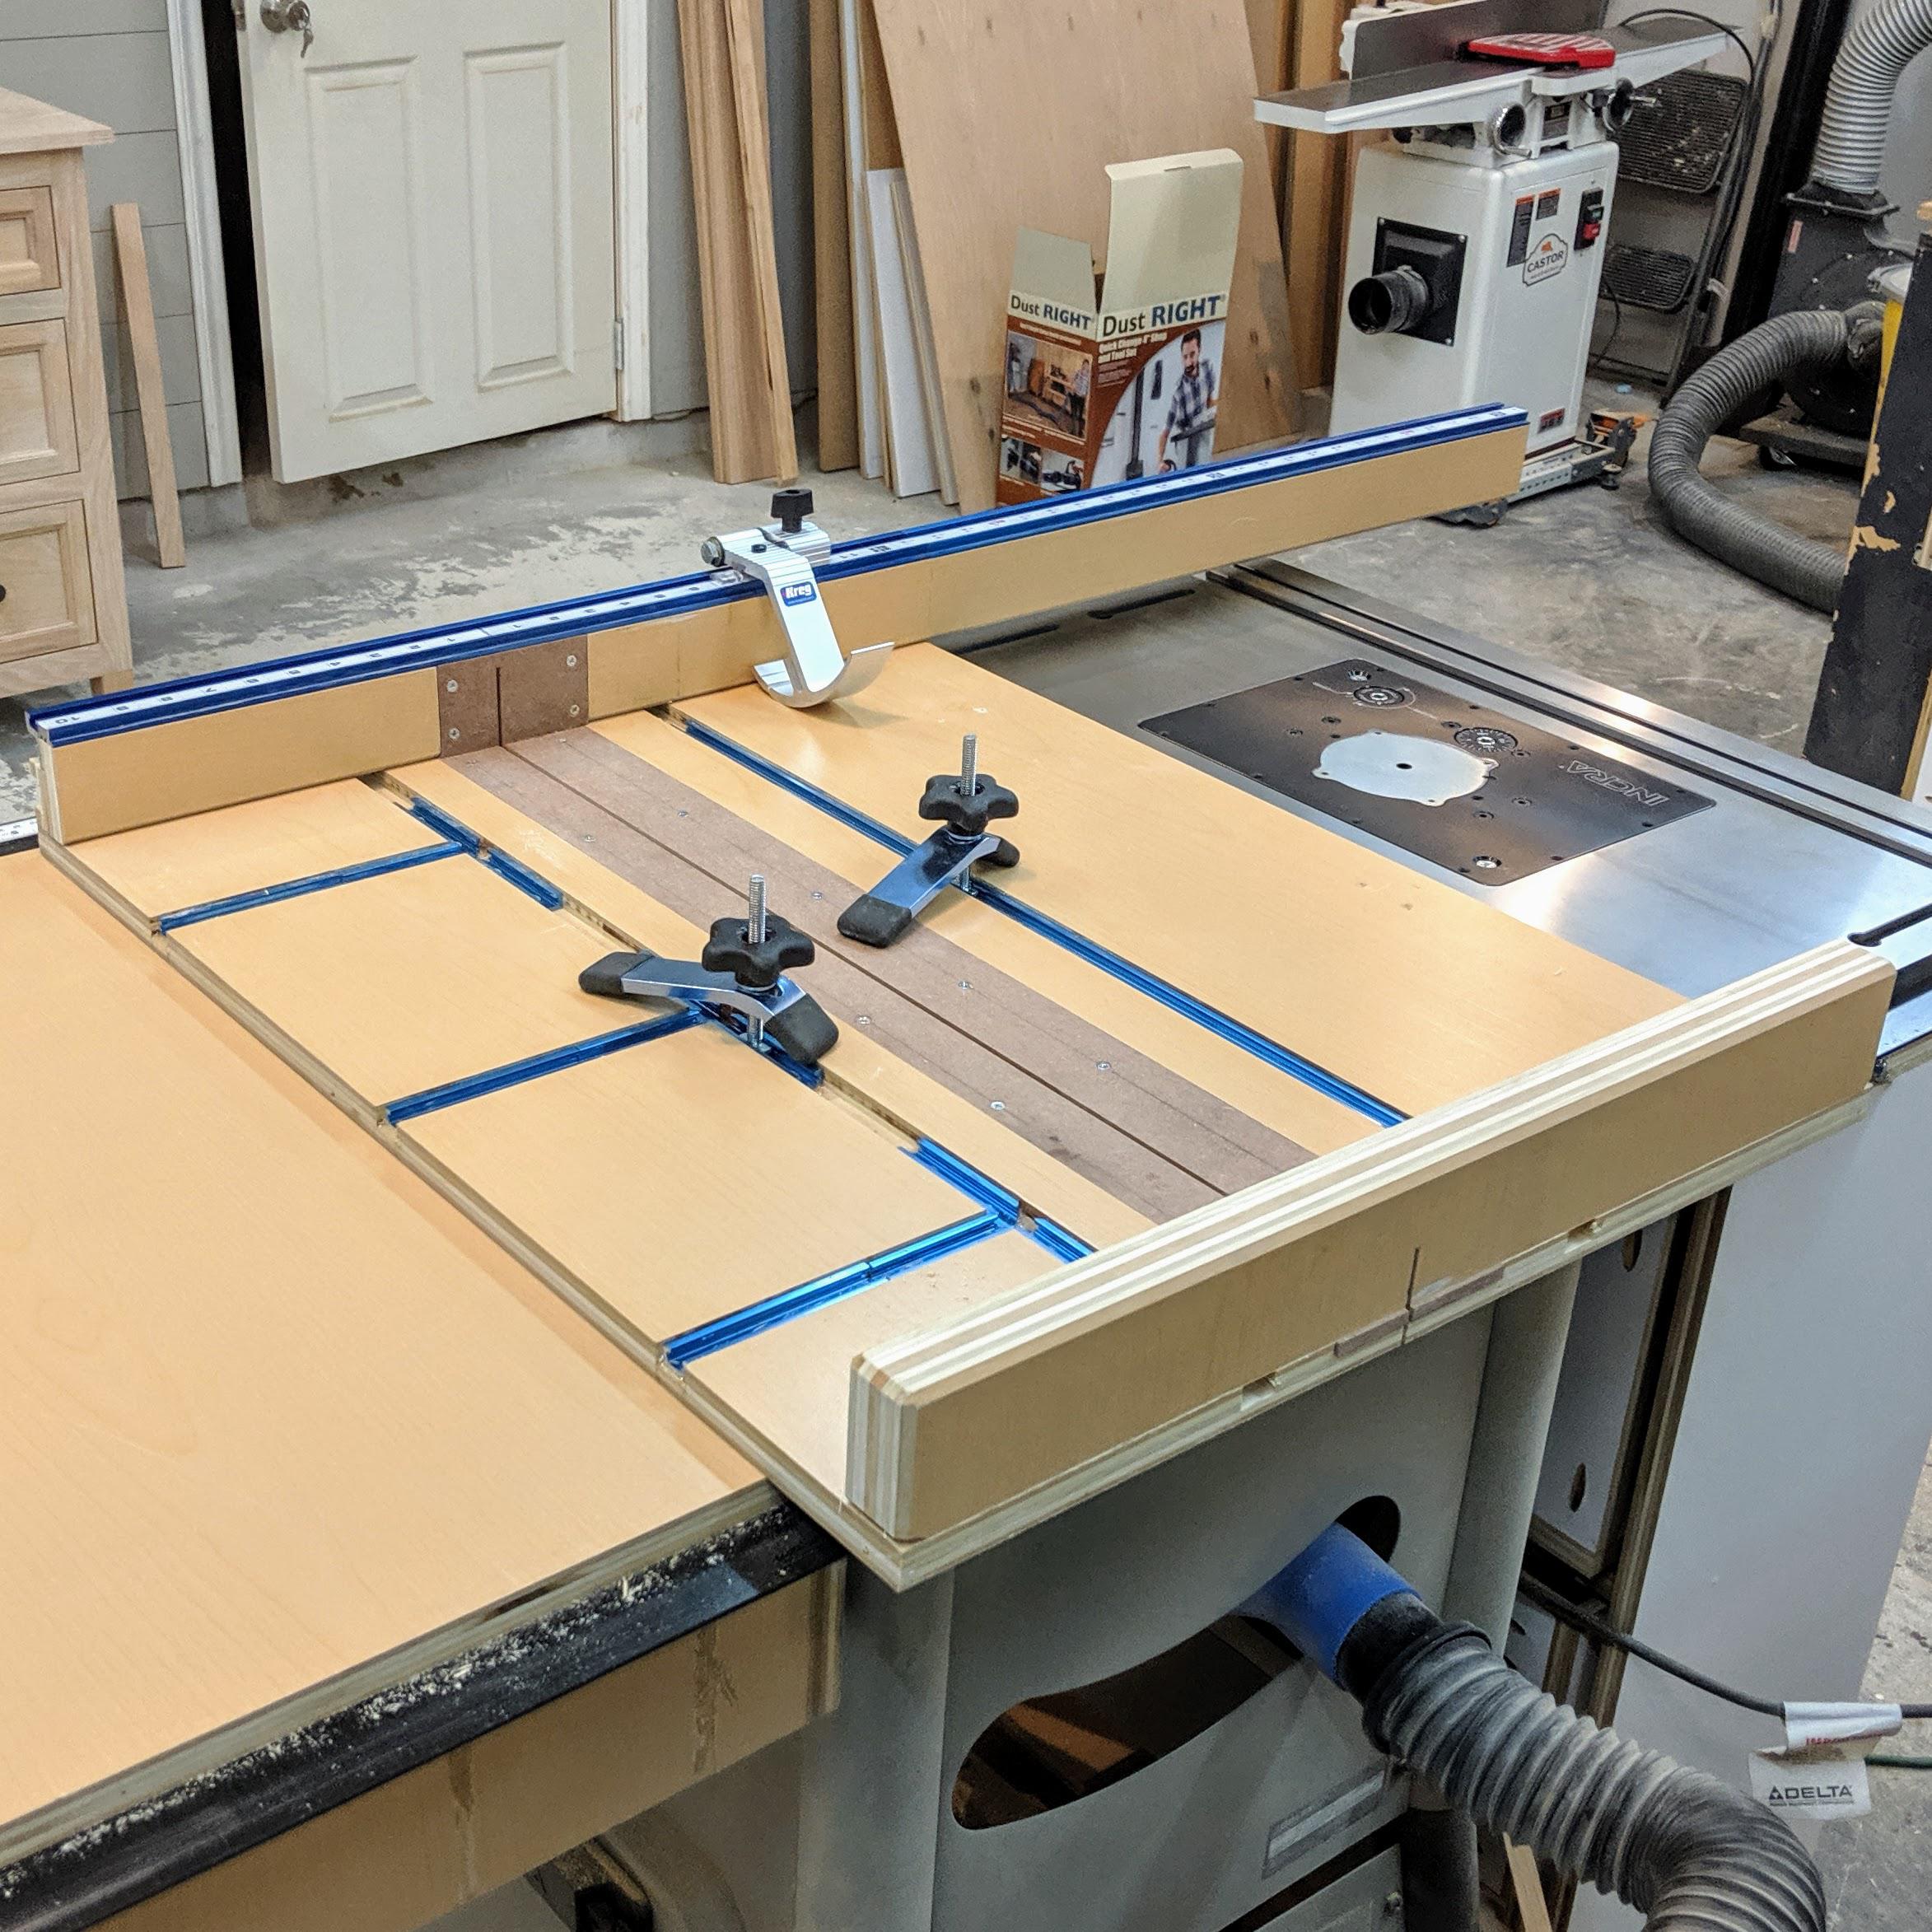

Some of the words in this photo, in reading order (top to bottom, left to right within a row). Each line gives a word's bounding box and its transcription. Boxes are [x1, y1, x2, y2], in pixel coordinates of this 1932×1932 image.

[1526, 250, 1565, 273] CASTOR
[1010, 294, 1040, 317] Dust
[1043, 303, 1092, 331] RIGHT
[1103, 312, 1146, 338] Dust
[1150, 294, 1221, 328] RIGHT
[785, 584, 812, 599] Kreg
[1566, 759, 1670, 806] INCRA
[1785, 1785, 1853, 1800] DELTA
